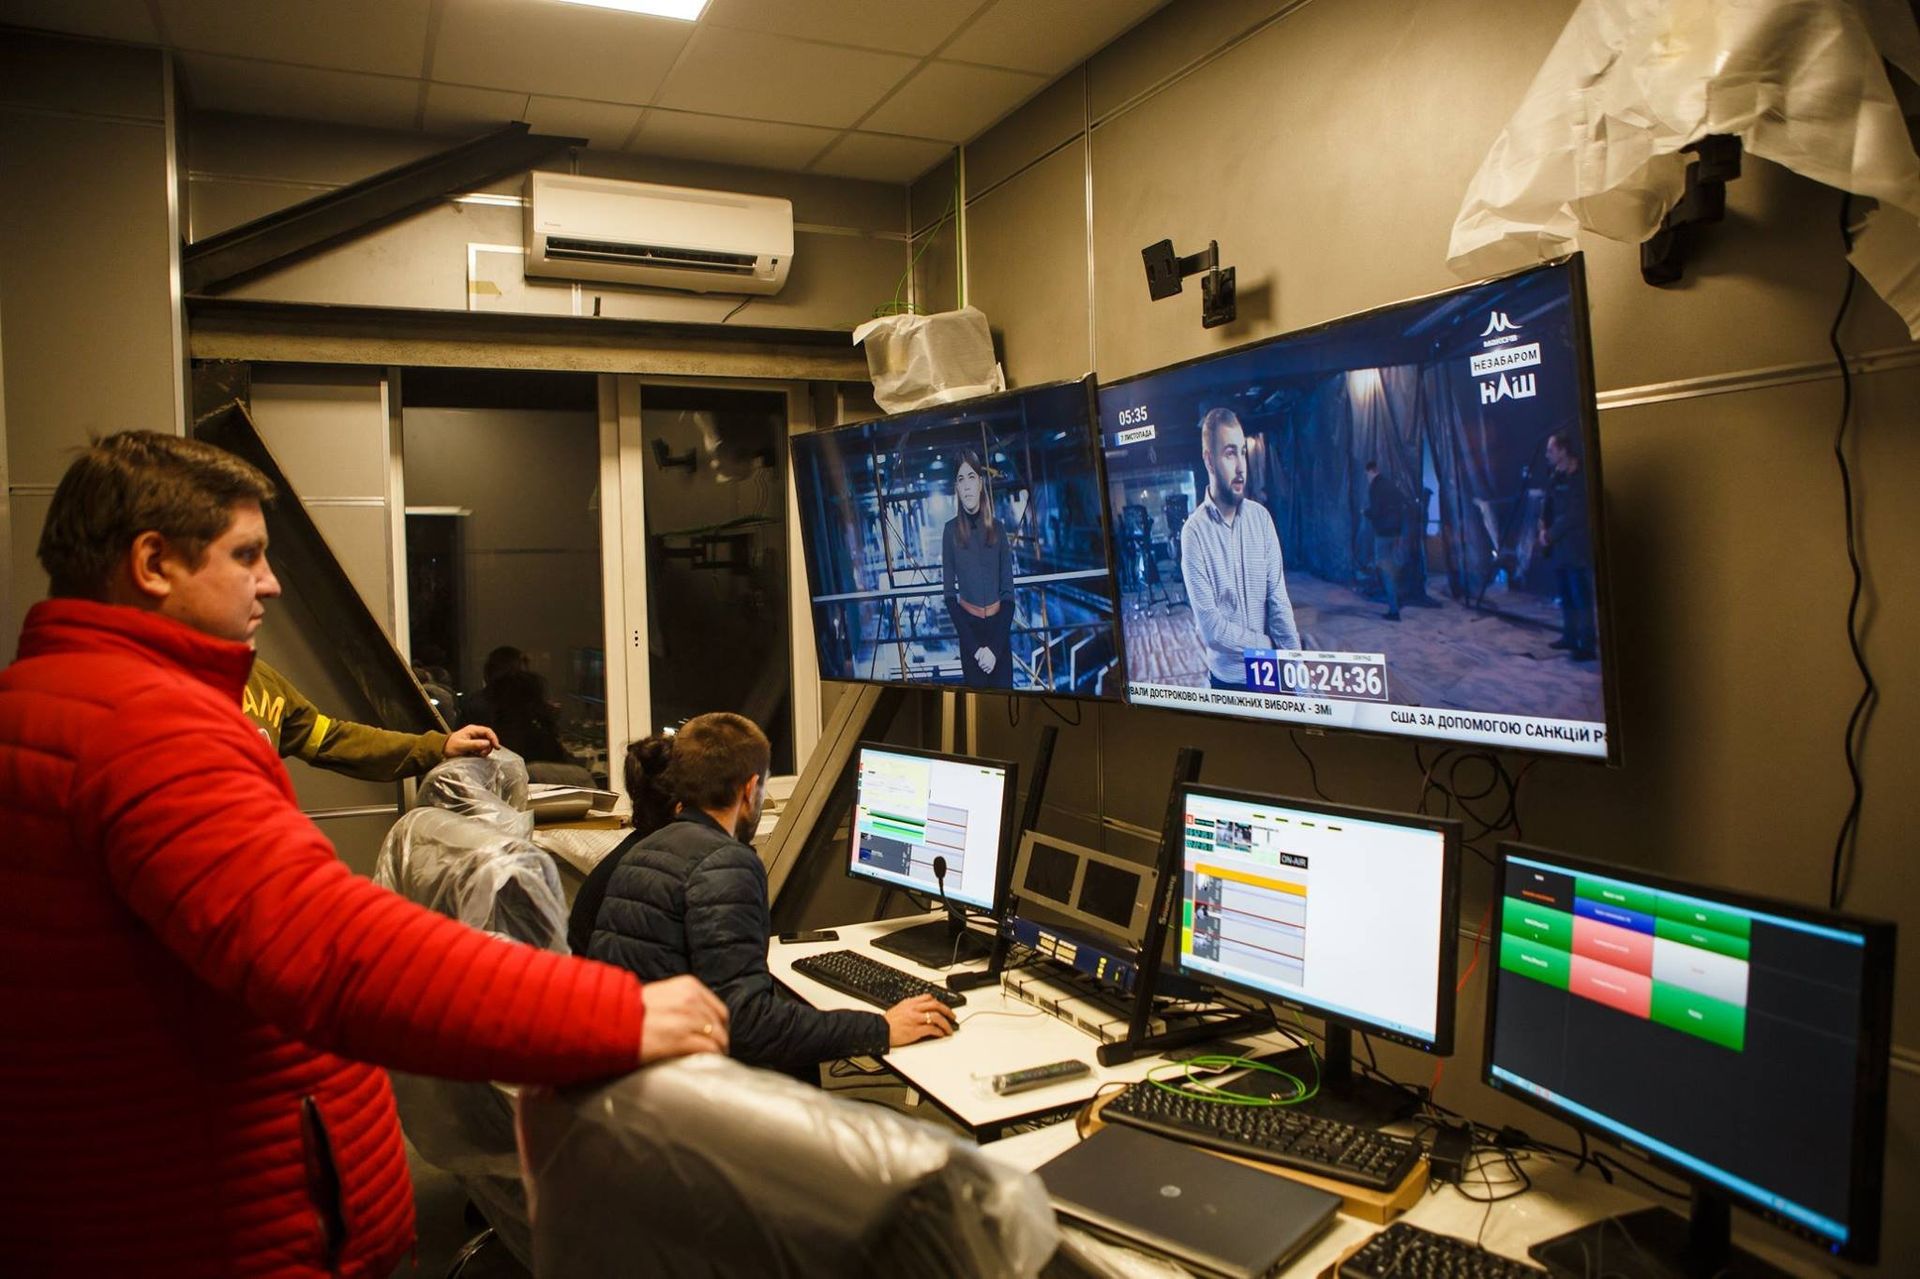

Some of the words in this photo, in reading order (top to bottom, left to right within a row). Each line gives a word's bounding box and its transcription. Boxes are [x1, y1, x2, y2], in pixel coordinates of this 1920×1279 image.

[1472, 349, 1538, 372] НЕЗАБАРОМ
[1479, 372, 1537, 405] НАШ
[1118, 404, 1148, 426] 05:35
[1249, 660, 1276, 687] 12
[1283, 662, 1383, 695] 00:24:36
[1129, 685, 1149, 697] ВАЛИ
[1149, 687, 1198, 702] ДОСТРОКОВО
[1198, 693, 1211, 703] НА
[1264, 699, 1306, 714] ВИБОРАХ
[1390, 710, 1417, 725] США
[1420, 713, 1436, 727] ЗА
[1438, 715, 1522, 736] ДОПОМОГОЮ
[1525, 723, 1590, 743] САНКЦІЙ
[1281, 853, 1307, 868] ON-AIR
